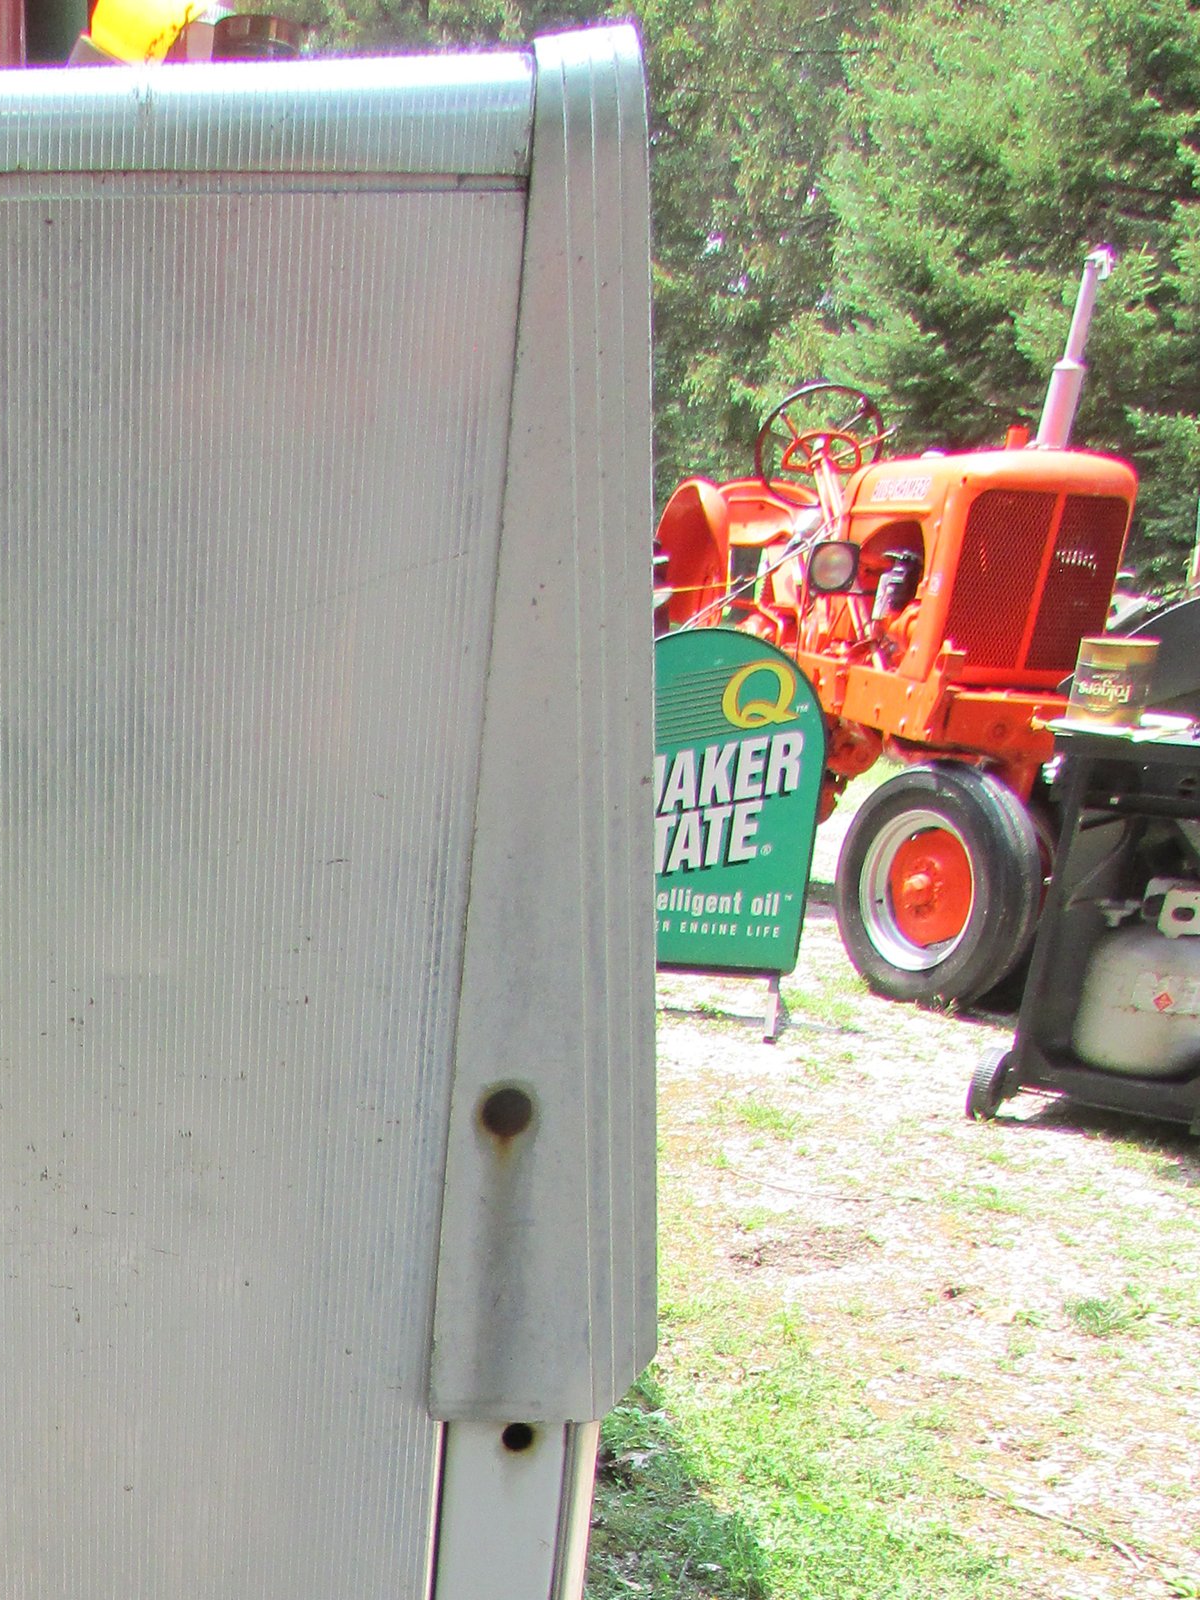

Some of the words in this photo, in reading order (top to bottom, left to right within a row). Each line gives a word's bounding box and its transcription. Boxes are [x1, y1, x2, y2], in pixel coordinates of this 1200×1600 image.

[721, 659, 800, 729] Q
[657, 888, 742, 917] elligent
[751, 892, 780, 917] oil
[680, 921, 737, 936] ENGINE
[746, 925, 780, 938] LIFE
